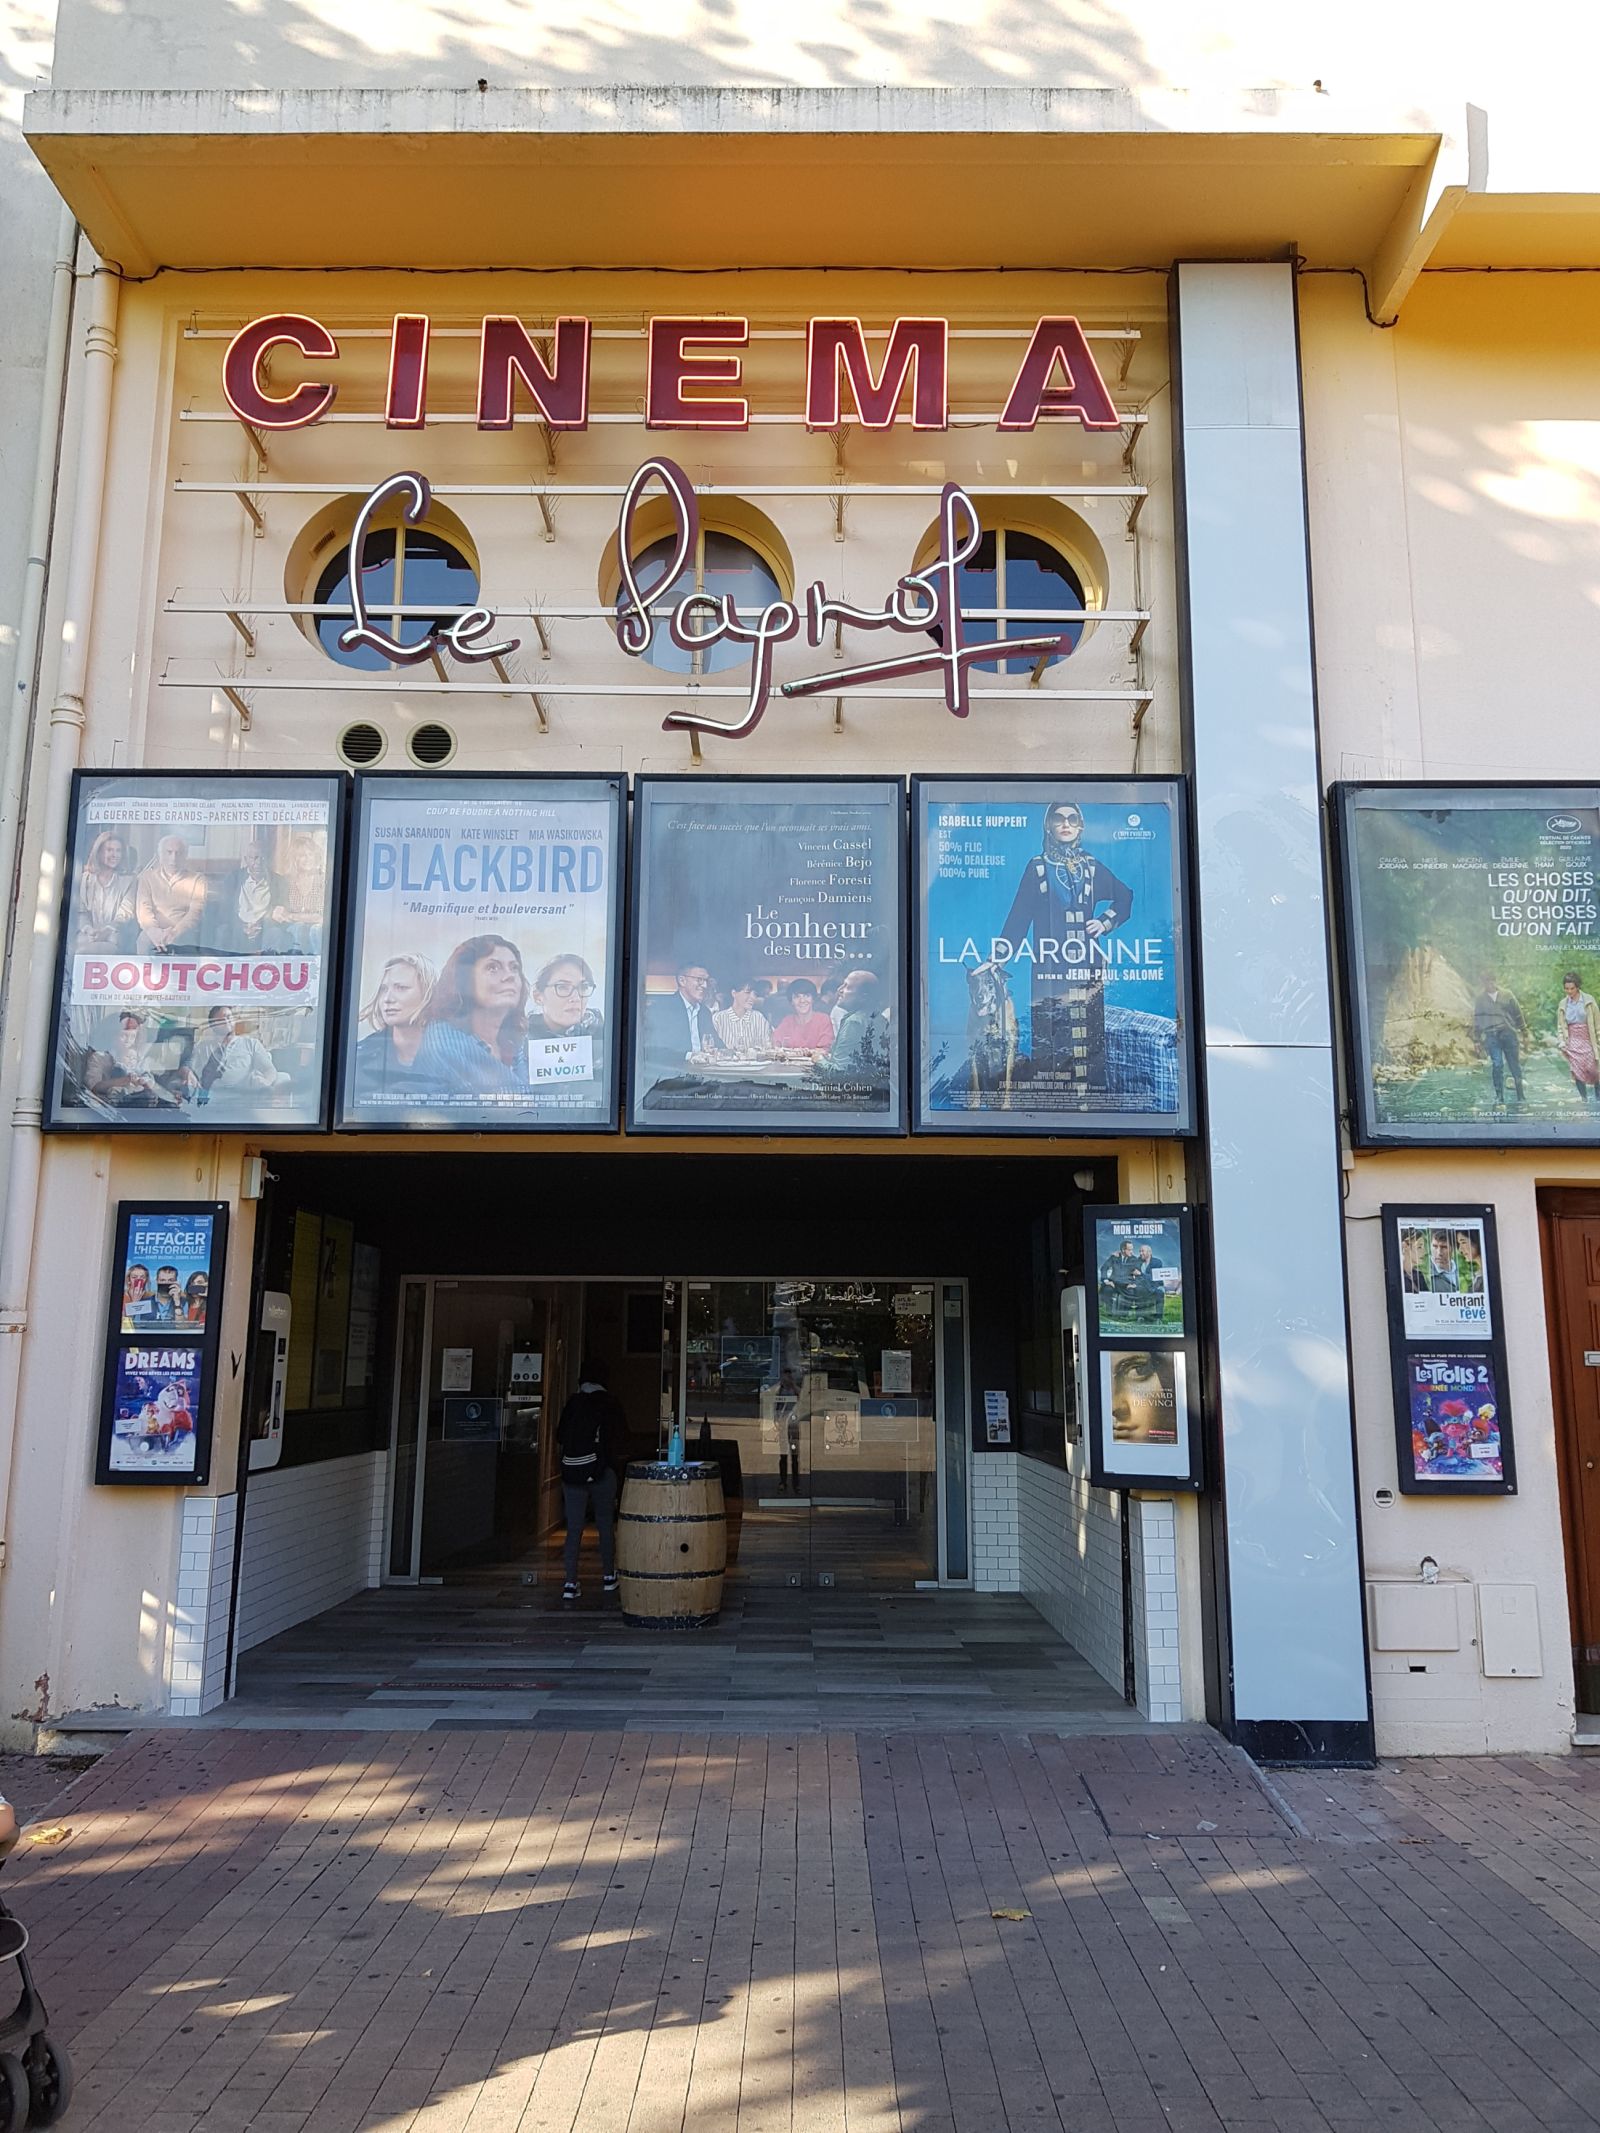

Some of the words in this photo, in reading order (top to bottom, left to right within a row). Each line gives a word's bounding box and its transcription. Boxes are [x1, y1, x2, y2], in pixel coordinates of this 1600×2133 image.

[222, 312, 1125, 432] CINEMA
[338, 470, 521, 664] Le
[89, 810, 100, 820] LA
[103, 810, 140, 820] GUERRE
[143, 810, 161, 820] DES
[165, 810, 249, 821] GRANDS-PARENTS
[252, 811, 269, 821] EST
[273, 808, 320, 821] DÉCLARÉE
[426, 807, 448, 816] COUP
[449, 808, 461, 816] DE
[461, 808, 494, 816] FOUDRE
[502, 808, 538, 818] NOTTING
[539, 809, 556, 818] HILL
[687, 819, 705, 832] face
[706, 823, 718, 831] au
[744, 823, 760, 833] que
[817, 823, 829, 832] ses
[938, 815, 983, 828] ISABELLE
[985, 815, 1028, 828] HUPPERT
[374, 826, 402, 838] SUSAN
[404, 827, 451, 839] SARANDON
[460, 828, 481, 840] KATE
[483, 829, 519, 841] WINSLET
[528, 829, 545, 841] MIA
[546, 829, 603, 841] WASIKOWSKA
[938, 829, 952, 839] EST
[798, 841, 830, 851] Vincent
[832, 838, 872, 850] Cassel
[938, 841, 963, 852] 50%
[964, 841, 982, 853] FLIC
[807, 859, 843, 869] Bérénice
[845, 855, 873, 871] Bejo
[938, 855, 963, 866] 50%
[964, 855, 1006, 866] DEALEUSE
[371, 842, 604, 894] BLACKBIRD
[938, 867, 966, 878] 100%
[968, 868, 990, 879] PURE
[790, 877, 827, 886] Florence
[829, 873, 872, 885] Foresti
[1488, 872, 1519, 887] LES
[1524, 871, 1594, 887] CHOSES
[778, 895, 815, 905] François
[818, 891, 873, 903] Damiens
[1502, 888, 1561, 904] QU'ON
[1562, 888, 1592, 905] DIT,
[478, 903, 490, 914] et
[756, 905, 779, 920] Le
[1491, 905, 1522, 920] LES
[1527, 904, 1597, 920] CHOSES
[744, 912, 872, 939] bonheur
[1497, 921, 1555, 937] QU'ON
[1556, 921, 1594, 936] FAIT
[764, 940, 791, 956] des
[938, 936, 983, 963] LA
[991, 936, 1164, 965] DARONNE
[82, 961, 309, 992] BOUTCHOU
[1065, 968, 1120, 981] JEAN-PAUL
[1122, 966, 1164, 981] SALOMÉ
[544, 1045, 560, 1054] EN
[562, 1043, 577, 1053] VF
[536, 1068, 552, 1077] EN
[554, 1065, 587, 1077] VO/ST
[812, 1082, 842, 1092] Daniel
[843, 1082, 873, 1092] Cohen
[1113, 1224, 1131, 1235] MON
[1133, 1224, 1163, 1235] COUSIN
[135, 1231, 206, 1245] EFFACER
[134, 1245, 206, 1255] L'HISTORIQUE
[1439, 1294, 1485, 1308] L'enfant
[1460, 1306, 1486, 1319] rêvé
[125, 1351, 195, 1370] DREAMS
[1415, 1366, 1432, 1382] Les
[1423, 1363, 1475, 1385] Trolls
[1477, 1365, 1489, 1383] 2
